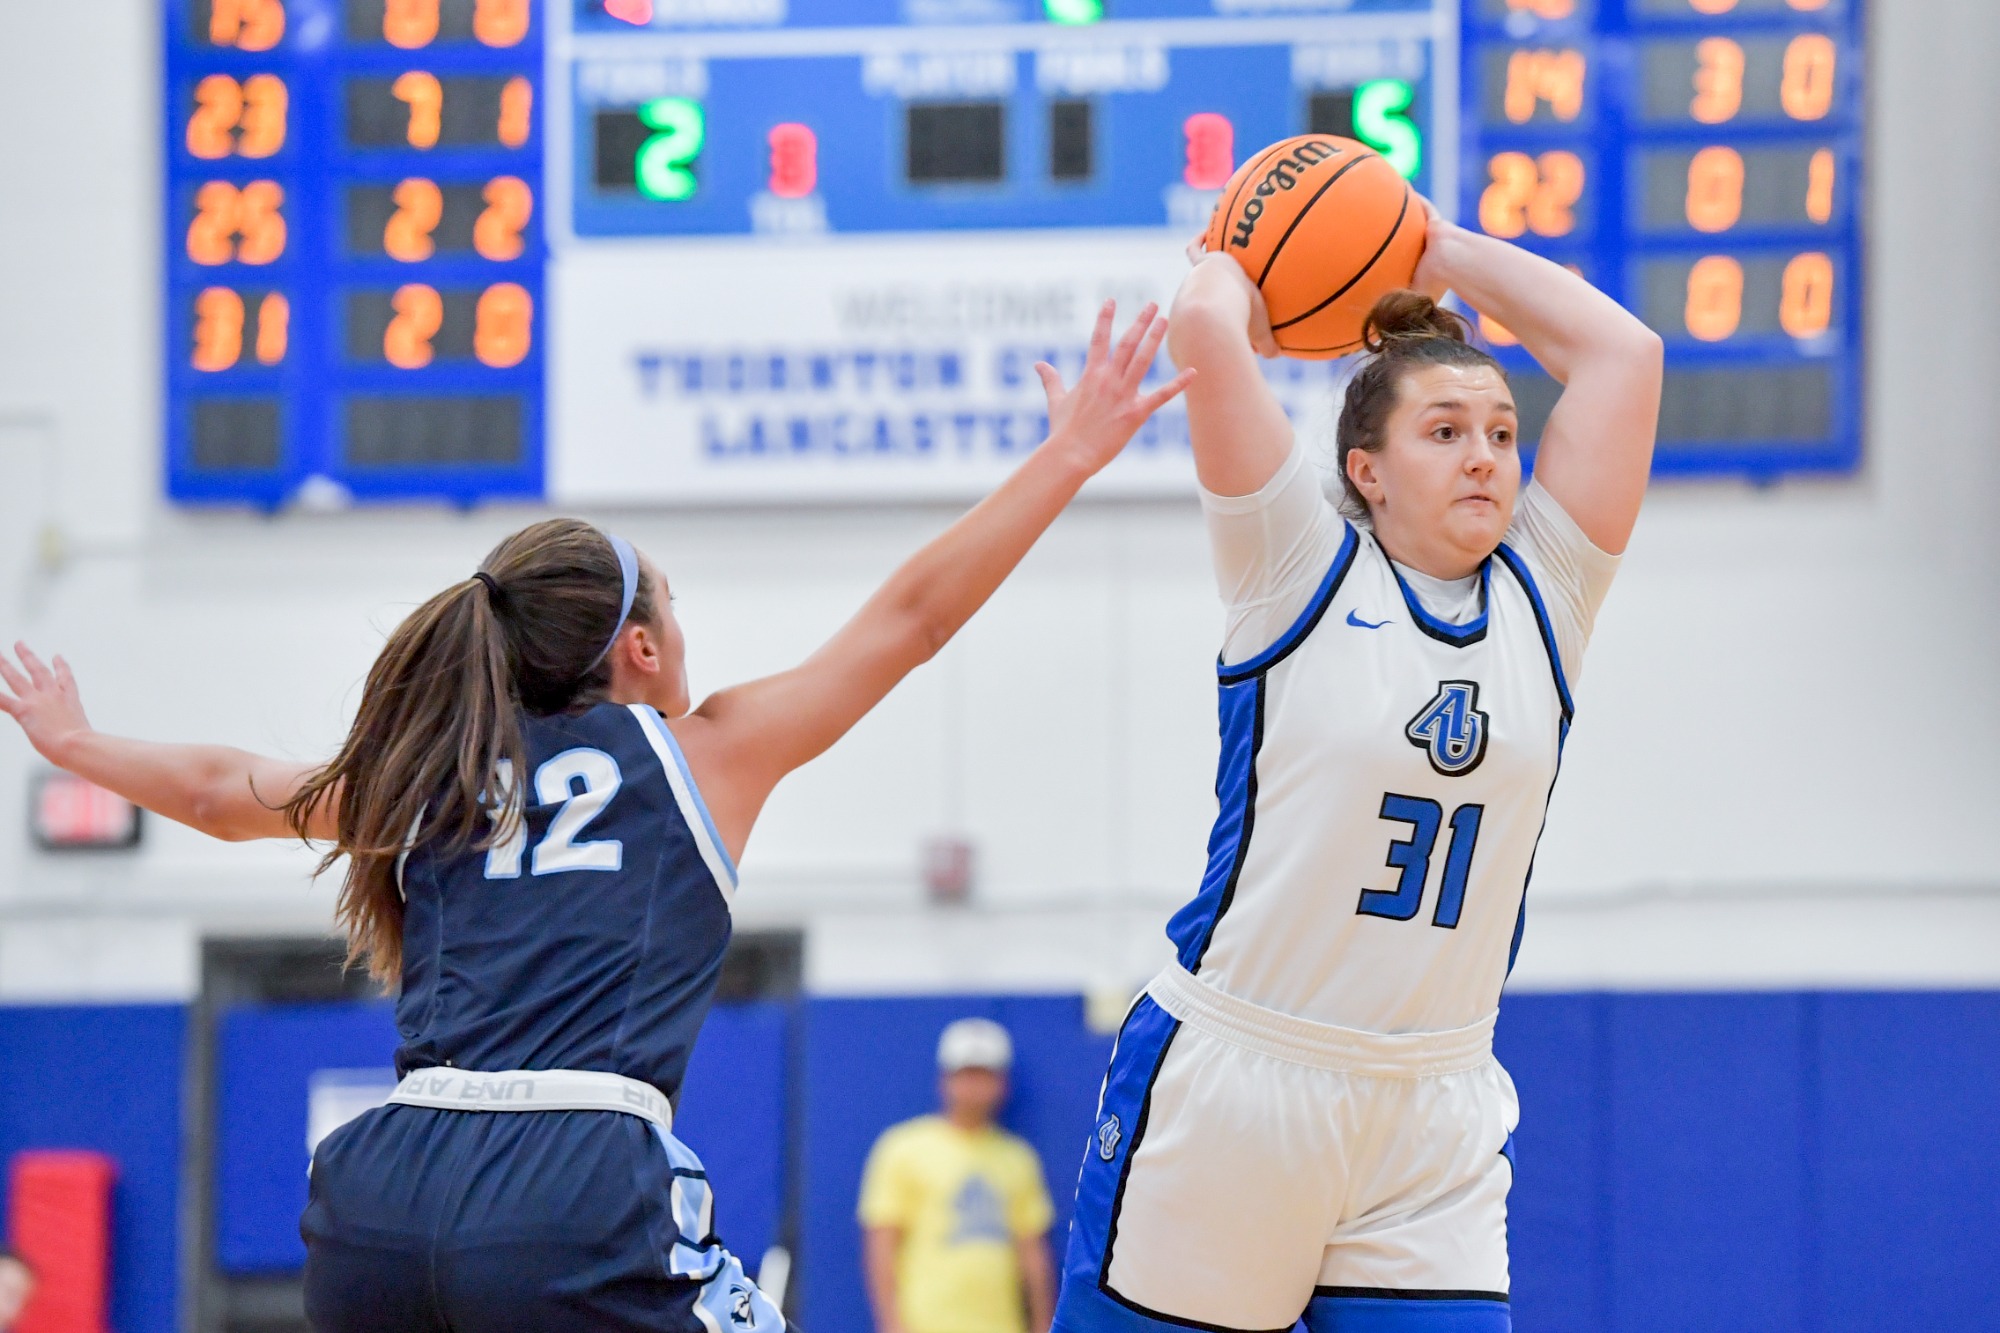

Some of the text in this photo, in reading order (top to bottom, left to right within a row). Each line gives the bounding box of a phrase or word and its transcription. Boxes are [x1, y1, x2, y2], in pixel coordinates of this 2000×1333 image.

[186, 74, 288, 159] 23
[497, 75, 533, 149] 1
[1504, 34, 1835, 124] 14 3 0
[635, 98, 705, 200] 2
[1352, 78, 1422, 180] 5
[186, 175, 533, 266] 25 2 2
[1231, 141, 1342, 249] Wilson
[1479, 146, 1834, 238] 22 0 1
[191, 286, 290, 372] 31
[384, 283, 443, 369] 2
[1685, 255, 1744, 341] 0
[1779, 252, 1833, 340] 0
[634, 348, 966, 394] THORNTON
[476, 747, 623, 879] 12
[1355, 792, 1485, 929] 31
